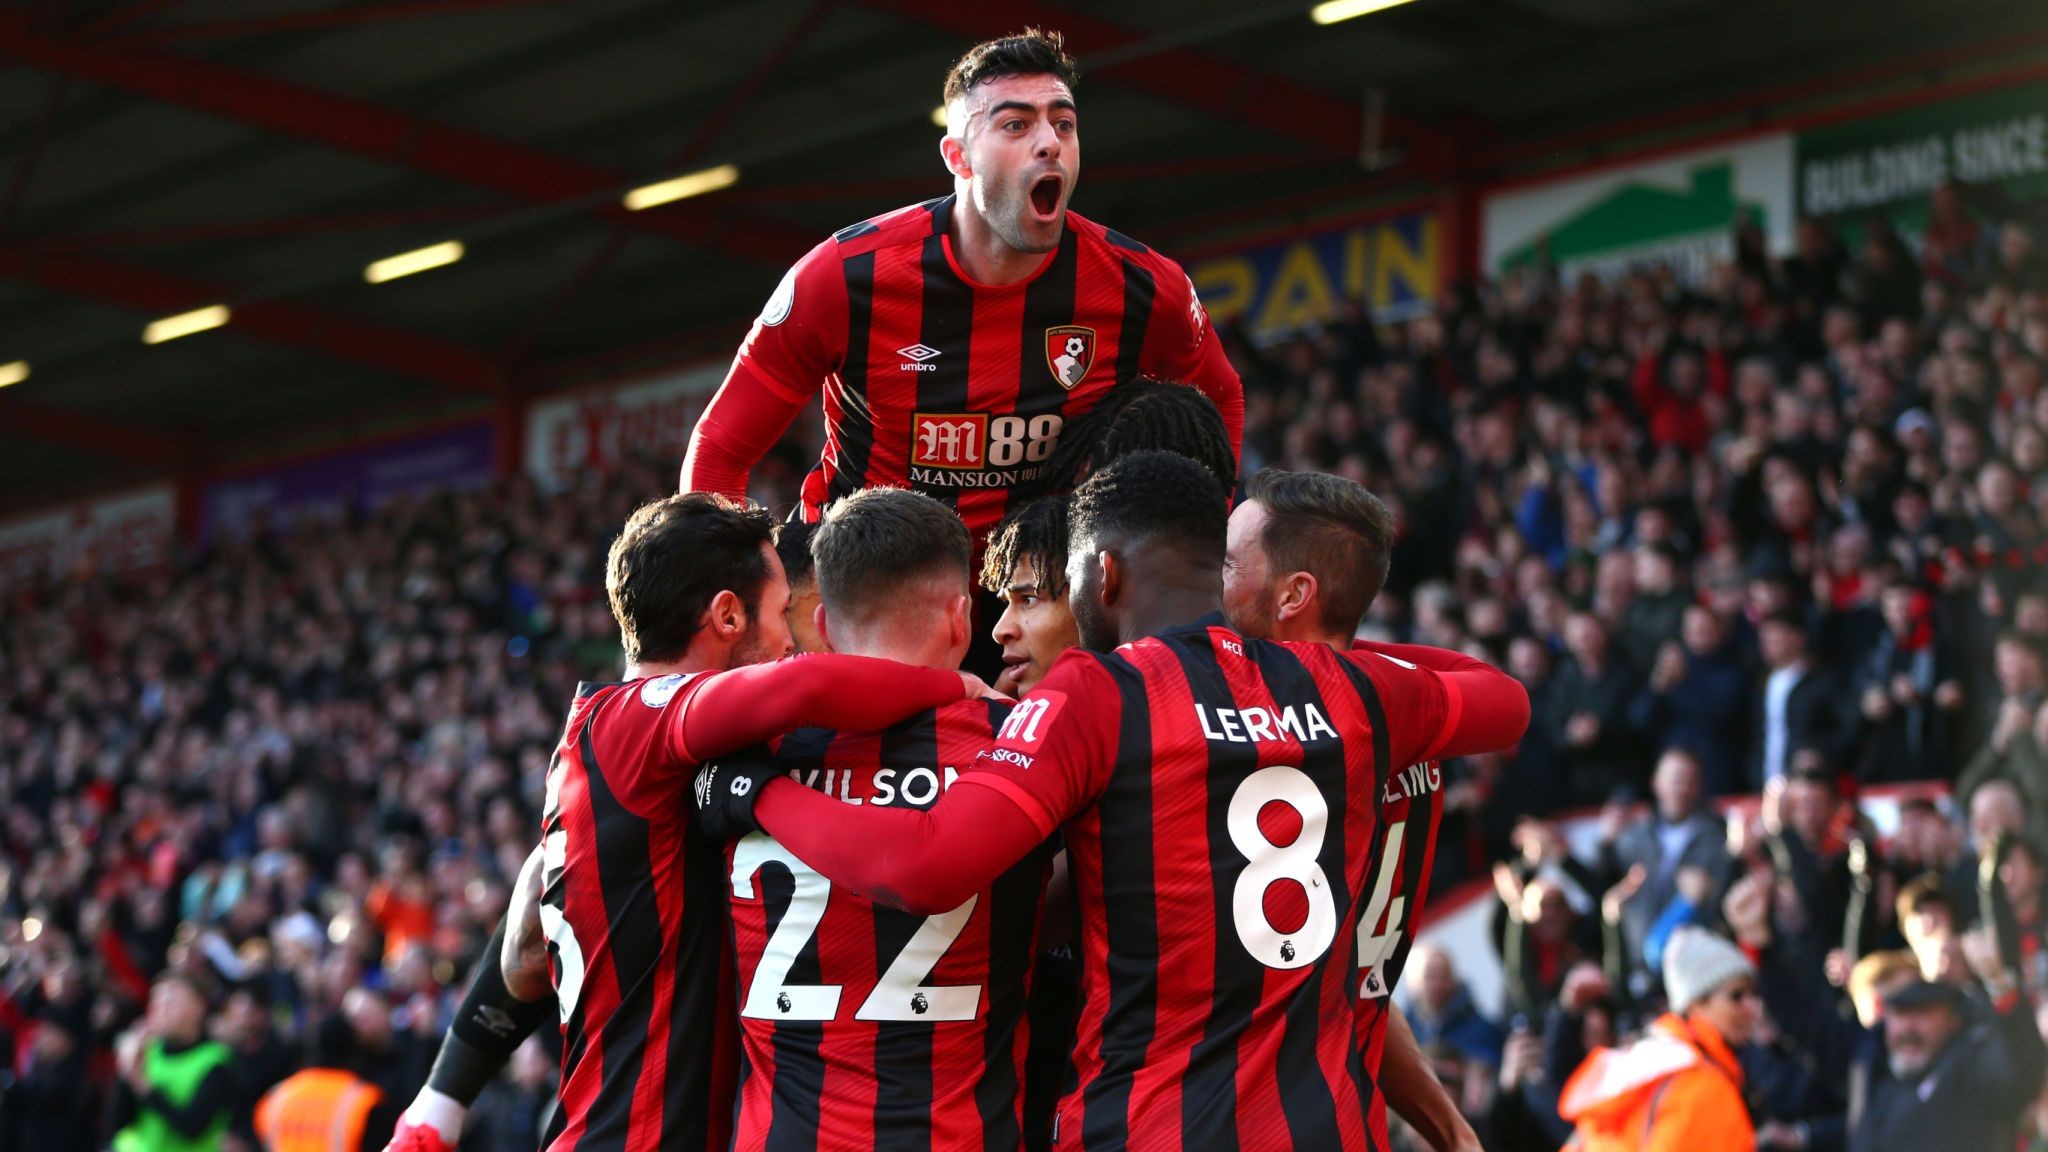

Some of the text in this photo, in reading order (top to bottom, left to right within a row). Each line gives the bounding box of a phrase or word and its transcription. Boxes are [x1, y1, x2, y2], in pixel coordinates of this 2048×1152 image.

[900, 361, 937, 372] umbro
[910, 467, 1019, 488] MANSION
[1194, 702, 1339, 743] LERMA
[705, 765, 718, 805] umbro
[730, 775, 752, 797] 8
[1382, 761, 1441, 804] LING
[1226, 765, 1337, 970] 8
[728, 830, 984, 1021] 22
[1357, 821, 1406, 1000] 4
